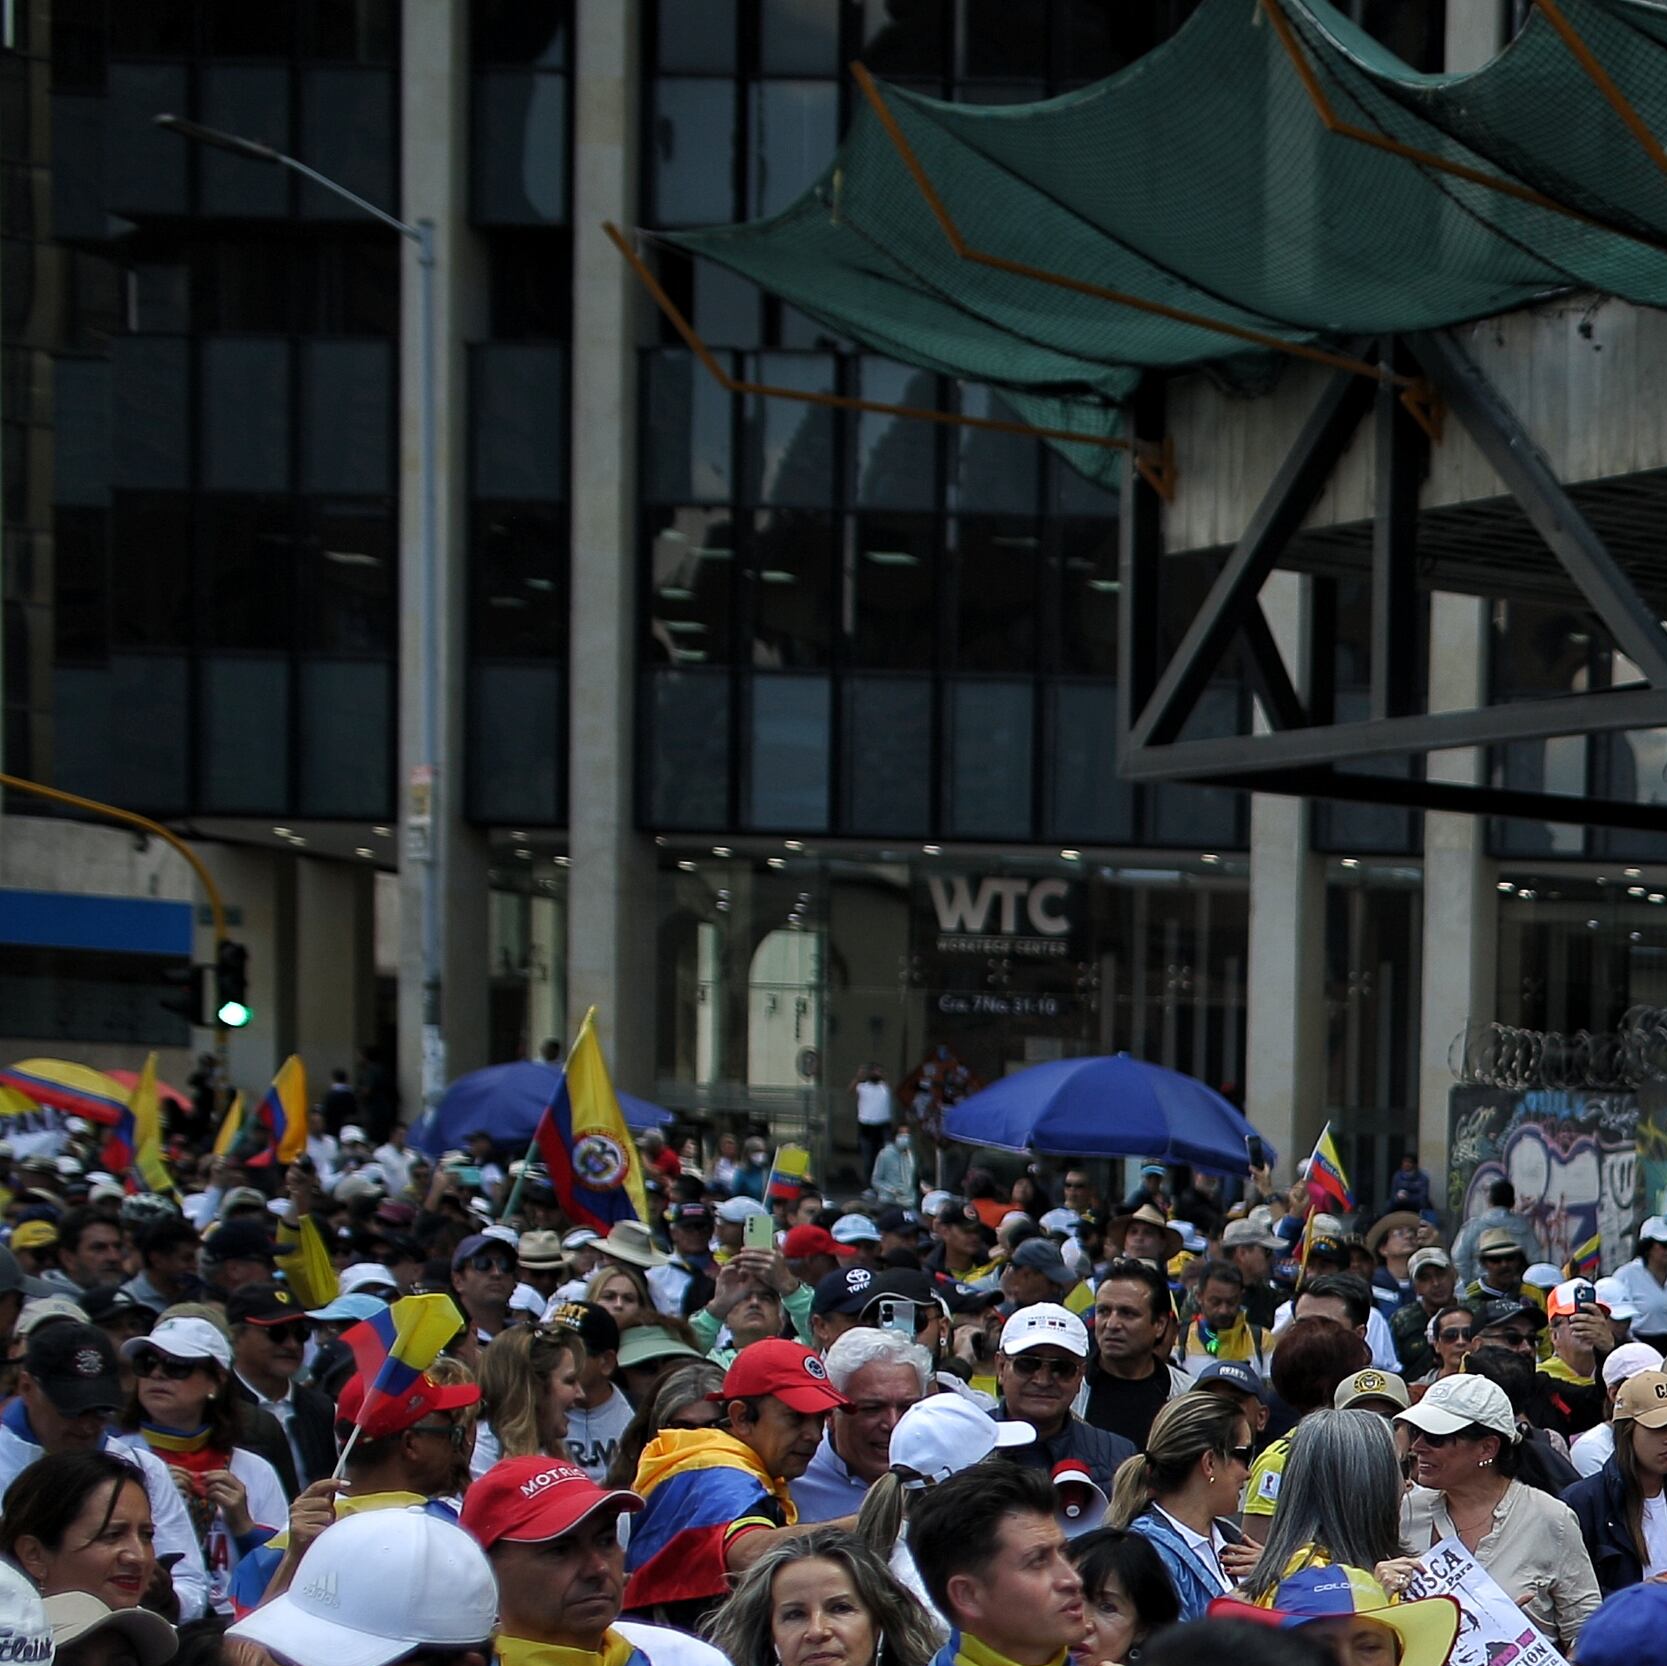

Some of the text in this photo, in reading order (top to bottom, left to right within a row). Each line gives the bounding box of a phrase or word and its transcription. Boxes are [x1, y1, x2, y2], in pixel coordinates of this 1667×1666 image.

[929, 877, 1069, 936] WTC
[1446, 1562, 1473, 1587] Para
[303, 1584, 339, 1607] adidas
